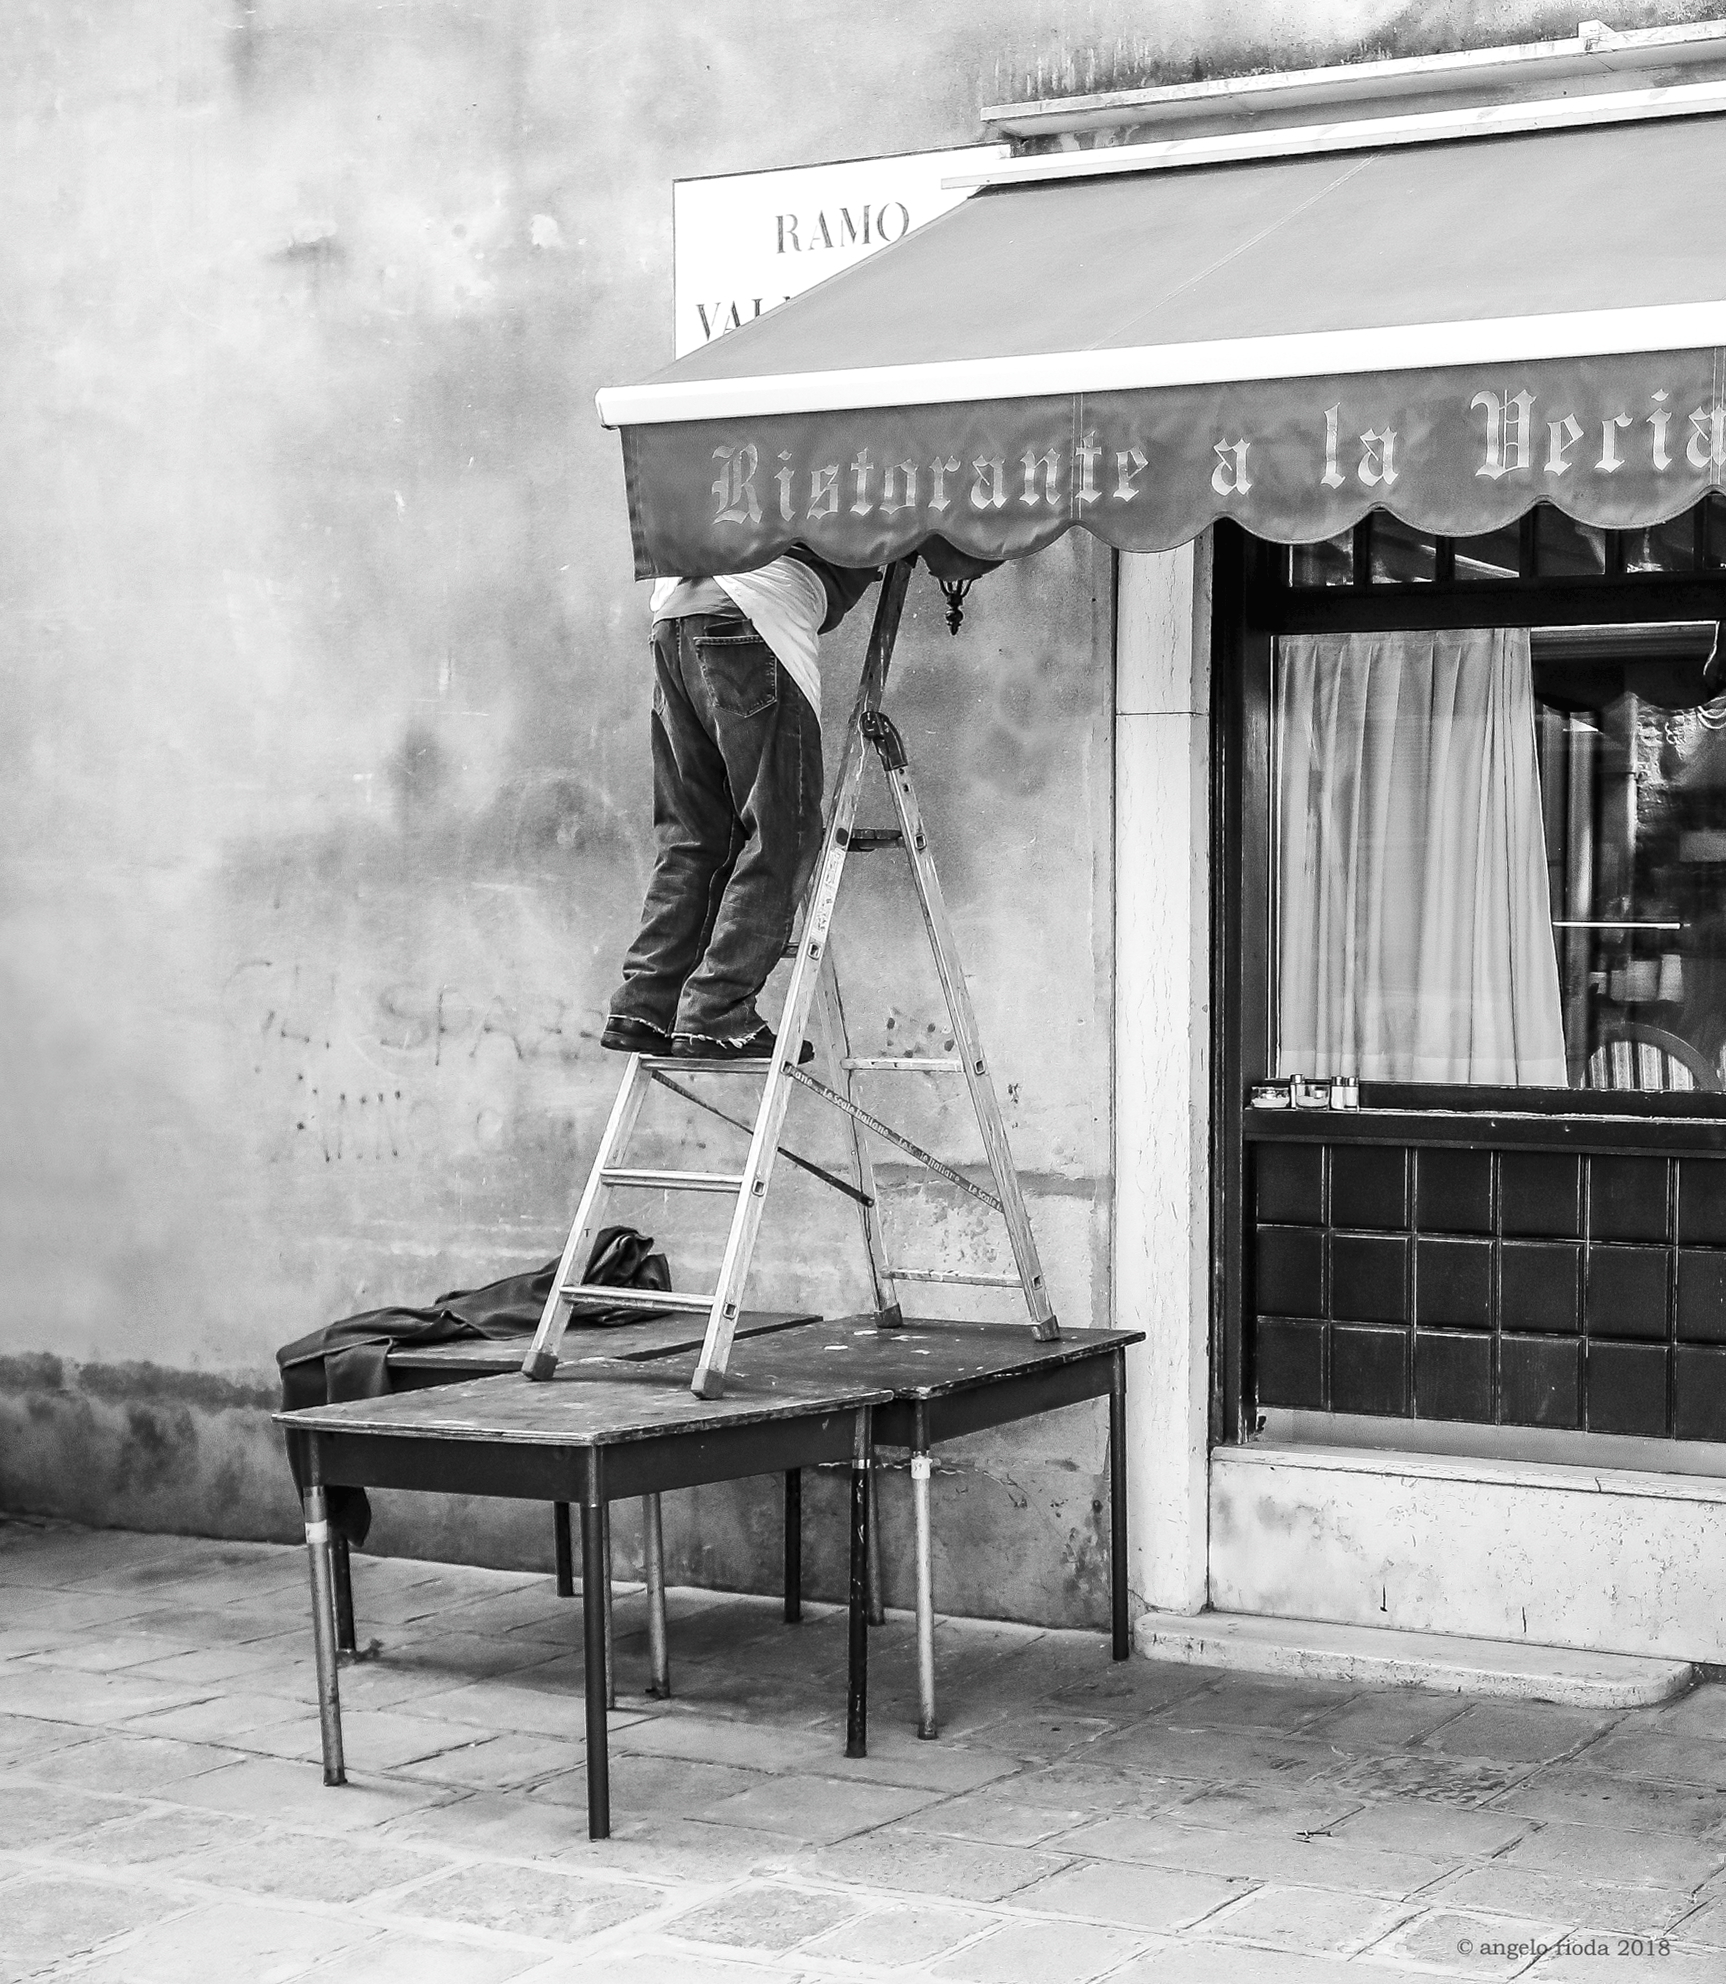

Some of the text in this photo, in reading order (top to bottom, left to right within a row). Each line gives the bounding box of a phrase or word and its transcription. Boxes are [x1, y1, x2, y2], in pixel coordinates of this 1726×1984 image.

[775, 202, 910, 254] RAMO
[696, 296, 792, 342] VA
[711, 430, 1149, 525] Ristorante
[1211, 437, 1252, 496] a
[1320, 402, 1399, 489] la
